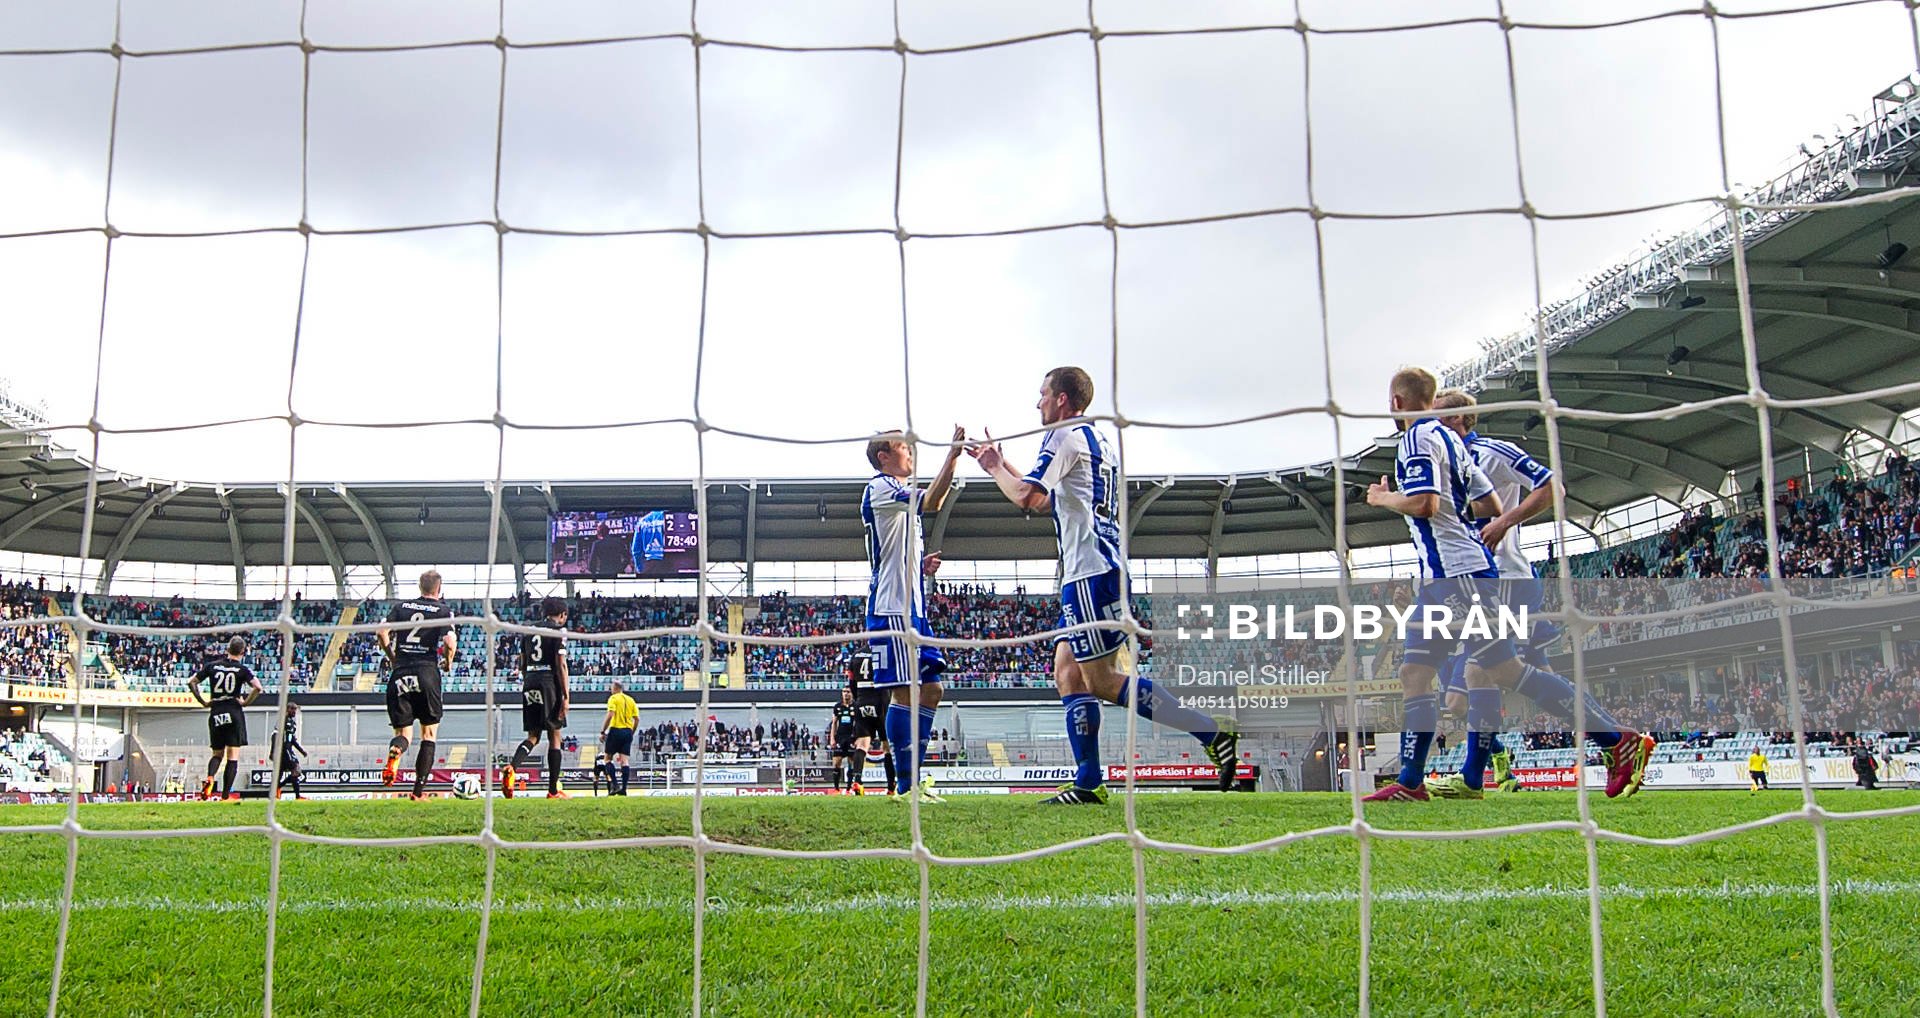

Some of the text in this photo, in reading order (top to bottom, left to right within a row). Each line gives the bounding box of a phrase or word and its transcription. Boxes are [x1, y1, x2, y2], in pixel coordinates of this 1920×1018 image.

[666, 520, 674, 531] 2
[690, 520, 696, 531] 1
[666, 535, 698, 547] 78:40
[406, 612, 425, 643] 2
[531, 634, 543, 662] 3
[1071, 638, 1089, 654] 15
[859, 658, 869, 680] 4
[213, 671, 236, 693] 20
[394, 675, 422, 697] NA
[523, 689, 544, 706] NA
[213, 712, 233, 727] NA
[859, 705, 878, 718] NA
[1403, 728, 1419, 760] SKF
[1137, 767, 1151, 776] vid
[1187, 767, 1193, 776] F
[1194, 766, 1214, 776] eller
